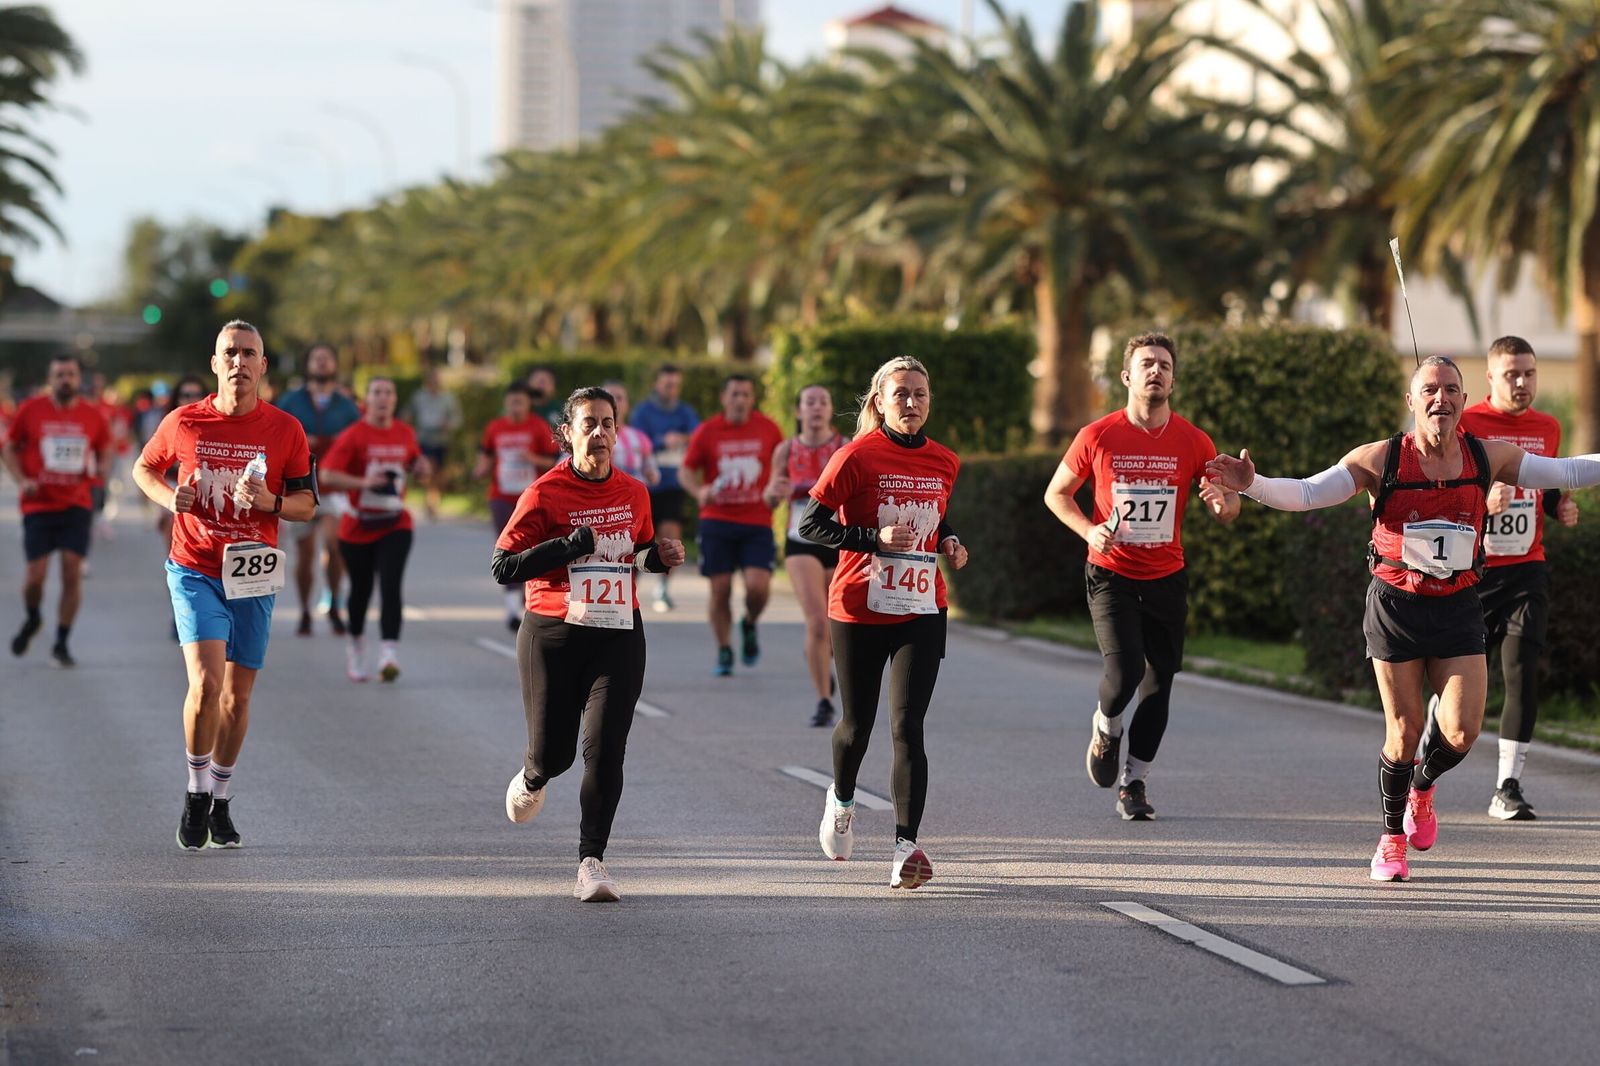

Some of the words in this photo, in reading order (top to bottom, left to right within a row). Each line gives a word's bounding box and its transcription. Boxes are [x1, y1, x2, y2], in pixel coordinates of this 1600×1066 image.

[195, 446, 230, 457] CIUDAD
[231, 449, 265, 459] JARD
[205, 440, 233, 449] CARRERA
[1112, 461, 1145, 469] CIUDAD
[1146, 460, 1177, 470] JARDÍN
[879, 480, 915, 489] CIUDAD
[888, 473, 915, 481] CARRERA
[570, 515, 605, 526] CIUDAD
[606, 510, 633, 523] JARDÍN
[578, 507, 606, 517] CARRERA
[606, 505, 625, 514] URBANA
[1122, 499, 1168, 522] 217
[1487, 513, 1528, 535] 180
[1432, 535, 1448, 561] 1
[231, 552, 278, 578] 289
[881, 564, 929, 594] 146
[581, 578, 626, 605] 121
